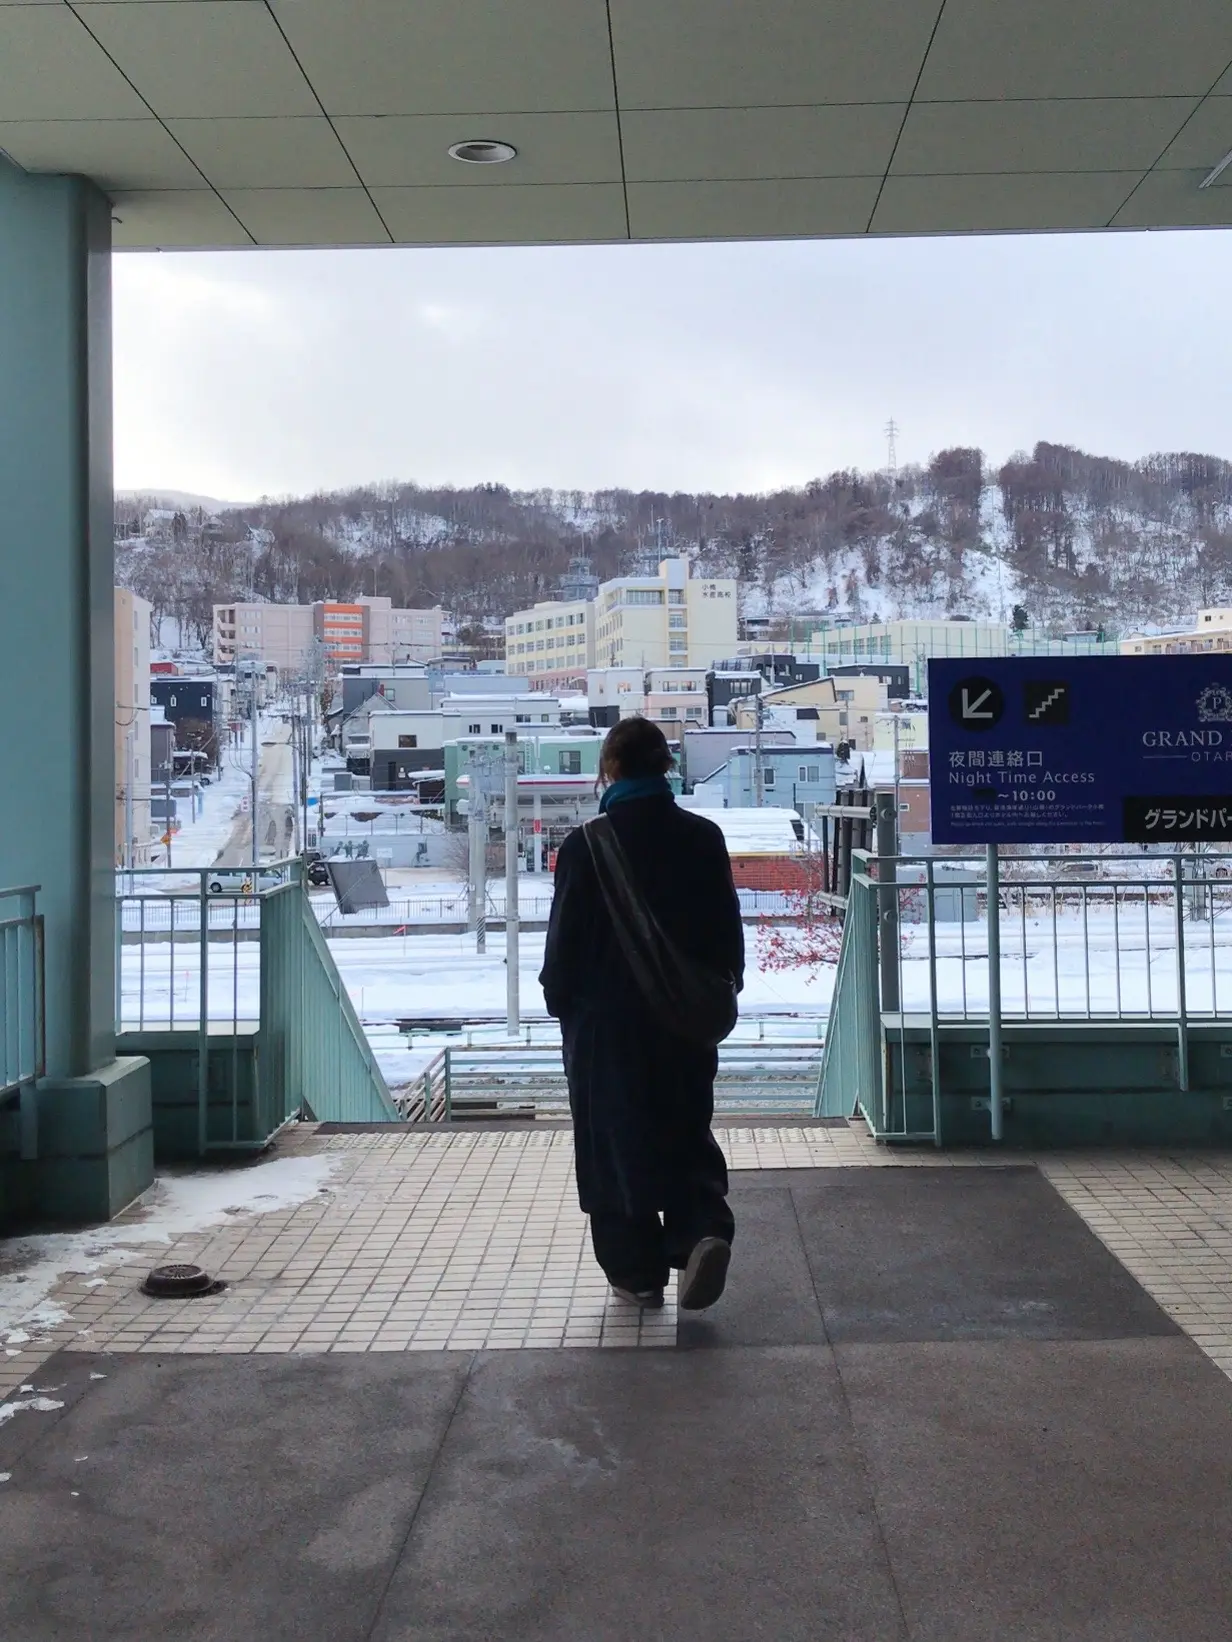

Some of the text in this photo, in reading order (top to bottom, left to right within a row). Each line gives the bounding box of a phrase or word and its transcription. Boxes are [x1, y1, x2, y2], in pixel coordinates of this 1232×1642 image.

[1143, 730, 1223, 747] GRAND
[949, 750, 1043, 767] 夜間連絡口
[949, 771, 1096, 786] Night Time Access
